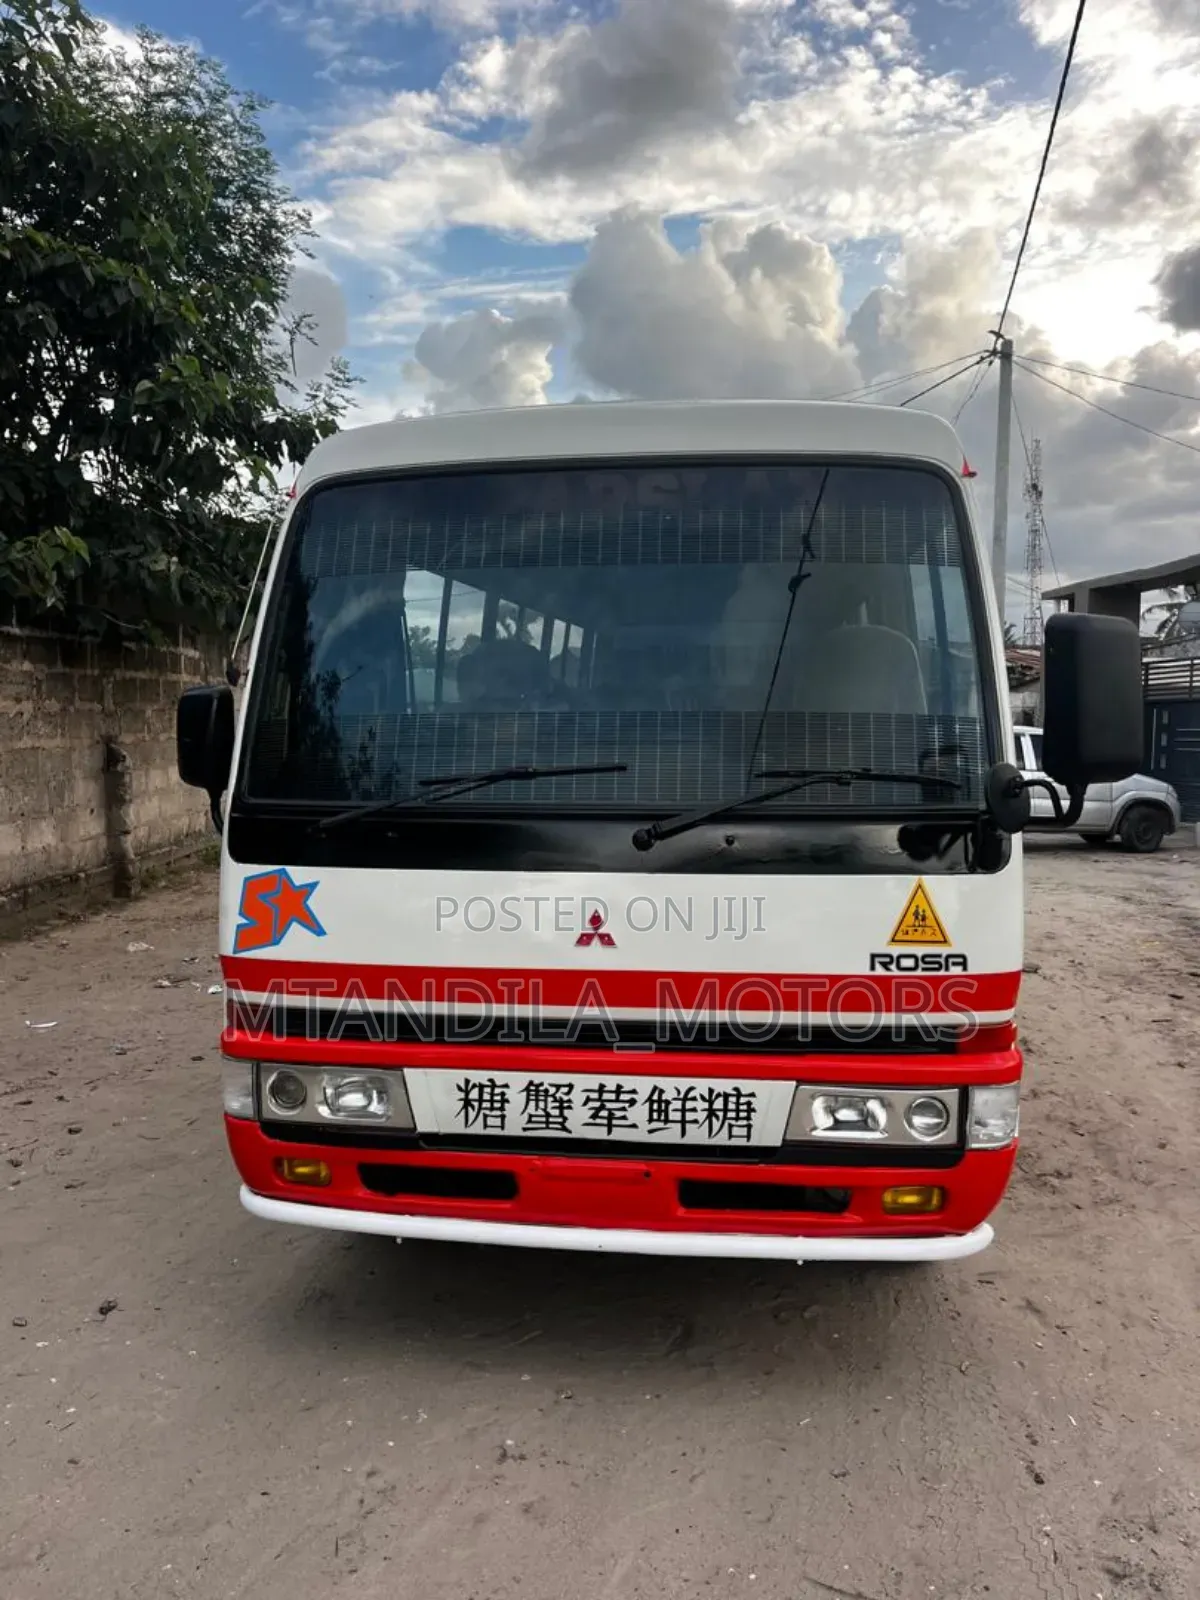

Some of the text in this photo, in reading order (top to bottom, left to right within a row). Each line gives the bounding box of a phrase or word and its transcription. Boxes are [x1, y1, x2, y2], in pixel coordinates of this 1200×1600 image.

[869, 953, 968, 972] ROSA
[454, 1077, 757, 1143] 糖蟹荤鲜糖
